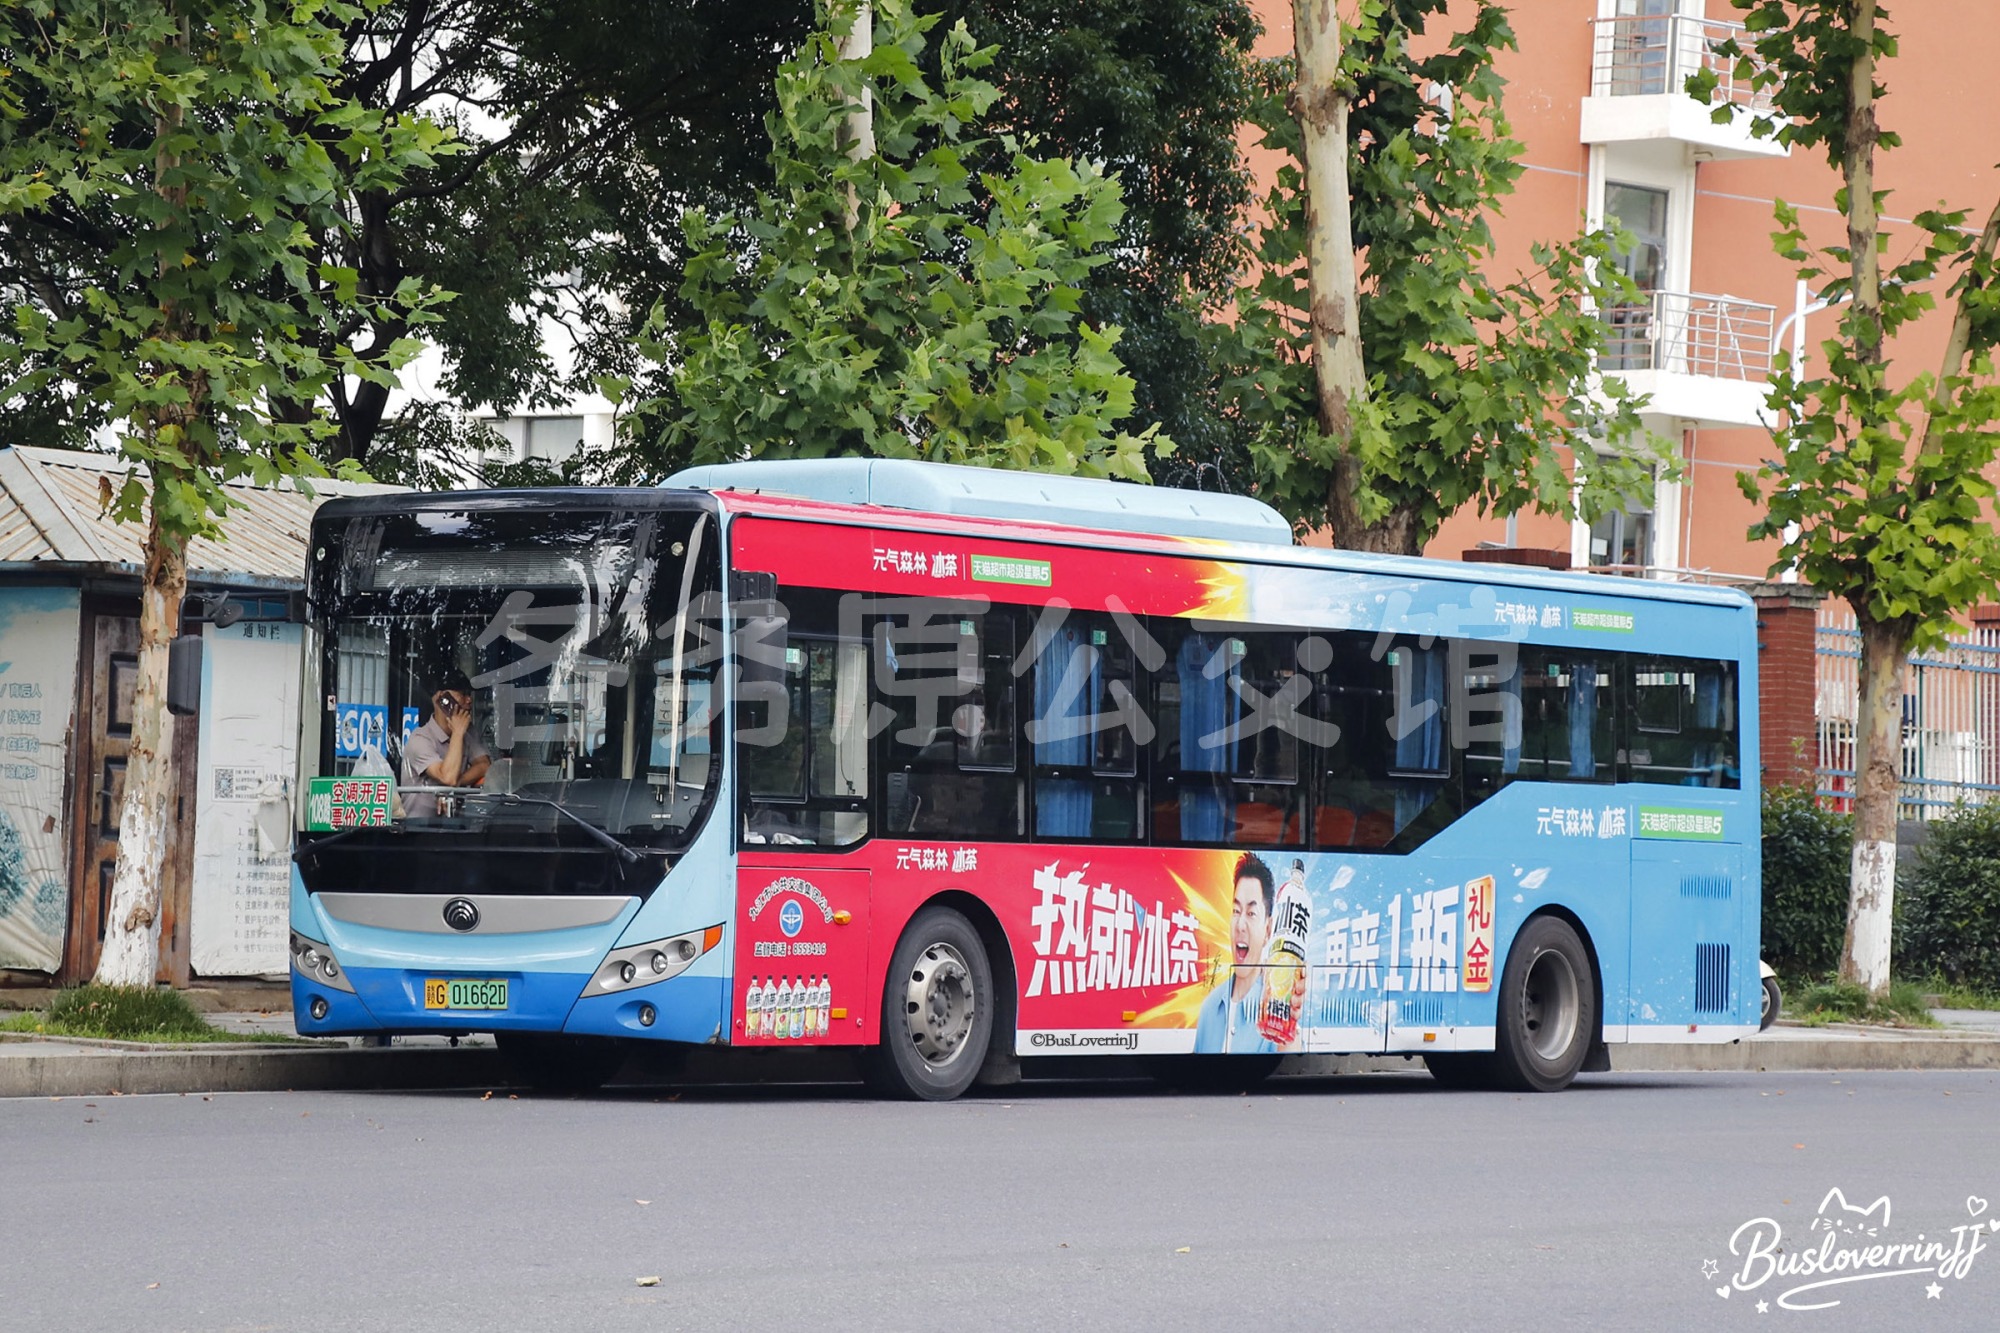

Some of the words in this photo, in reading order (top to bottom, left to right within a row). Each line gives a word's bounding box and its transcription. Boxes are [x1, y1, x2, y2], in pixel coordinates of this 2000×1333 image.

[873, 548, 928, 575] 元气森林
[931, 551, 958, 578] 冰茶
[1494, 602, 1538, 626] 元气森林
[1540, 604, 1562, 628] 冰茶
[331, 781, 389, 805] 空调开启
[330, 806, 387, 830] 票价2元
[1537, 806, 1595, 837] 元气森林
[1598, 805, 1626, 839] 冰茶
[896, 847, 948, 871] 元气森林
[952, 846, 978, 873] 冰茶
[1025, 859, 1200, 998] 热就冰茶
[1323, 885, 1460, 993] 再来1瓶
[1466, 887, 1491, 984] 礼金
